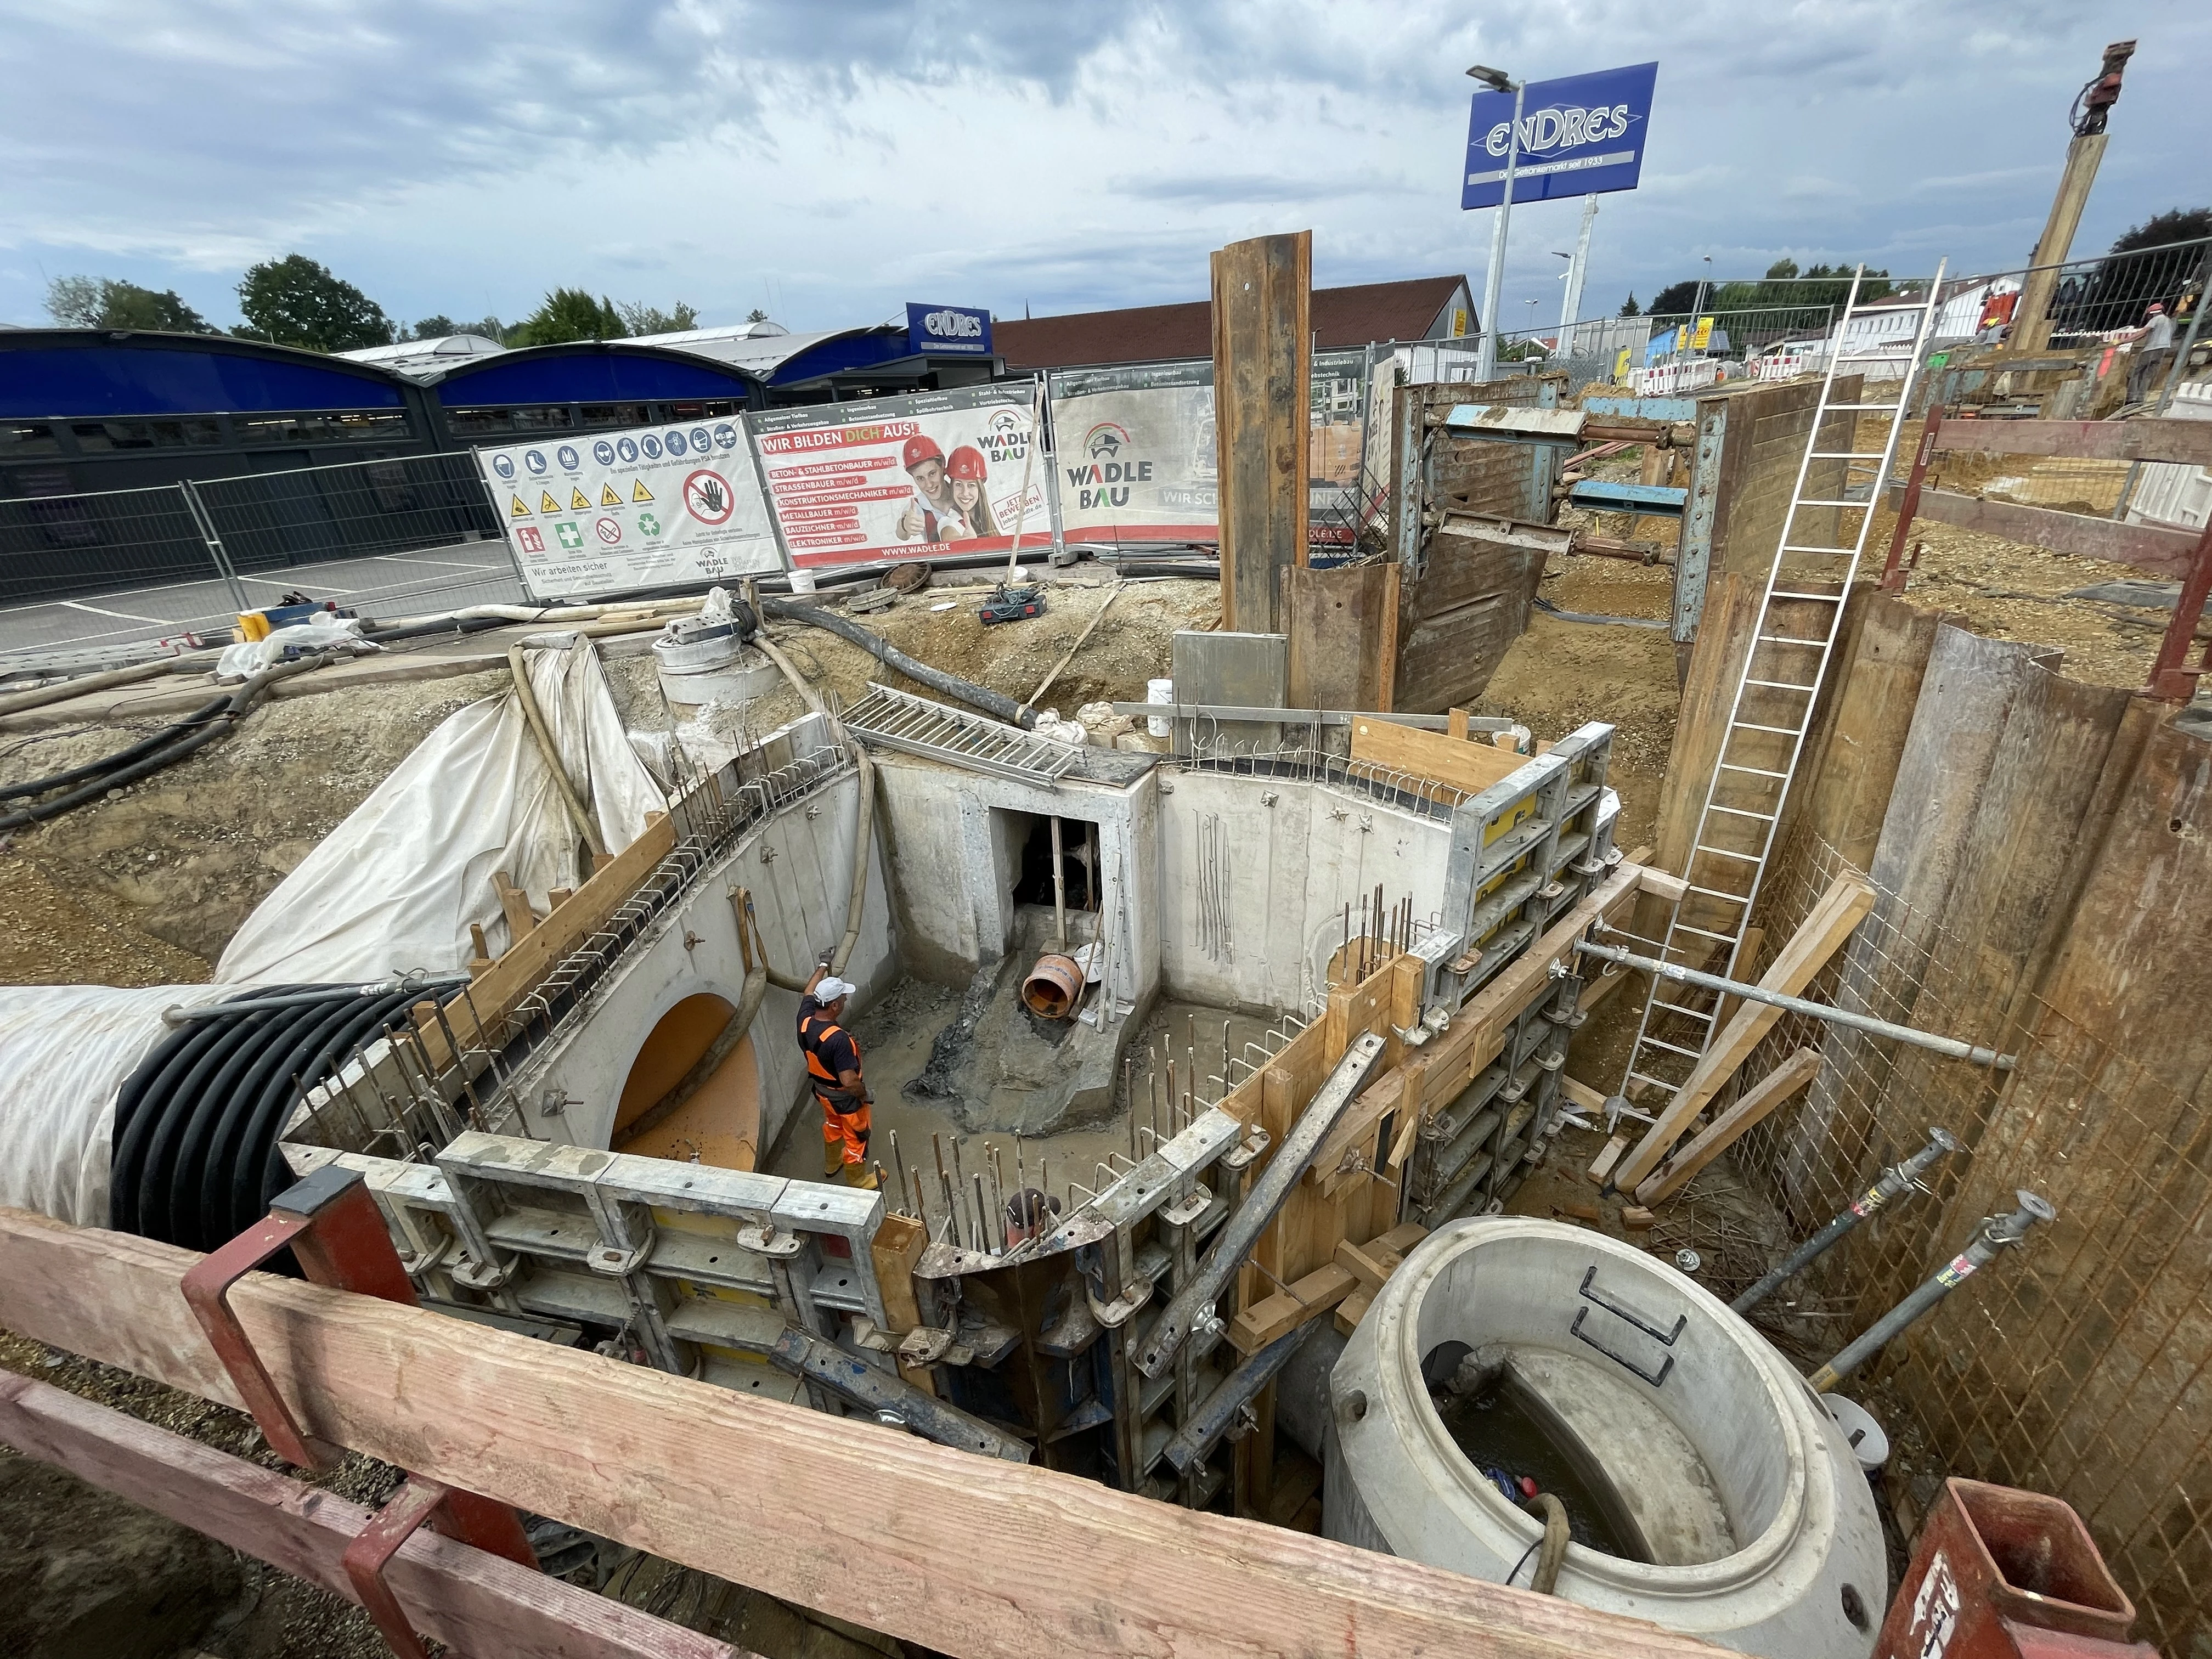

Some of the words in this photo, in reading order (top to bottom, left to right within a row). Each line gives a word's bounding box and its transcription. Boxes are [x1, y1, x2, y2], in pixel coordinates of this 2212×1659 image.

[1486, 104, 1629, 157] ENDRES
[1499, 171, 1508, 179] De
[1514, 162, 1567, 177] Getränkemarkt
[1568, 160, 1582, 170] seit
[1584, 157, 1603, 167] 1933
[924, 310, 982, 337] ENDRES
[1150, 379, 1200, 387] Betoninstandsetzung
[915, 396, 948, 405] Spezialtiefbau
[847, 404, 877, 413] Ingenieurbau
[916, 404, 954, 414] Spülbohrtechnik
[764, 415, 791, 424] Allgemeiner
[791, 420, 829, 428] Verkehrswegebau
[848, 412, 895, 422] Betoninstandsetzung
[763, 437, 792, 452] WIR
[793, 431, 843, 448] BILDEN
[845, 427, 880, 442] DICH
[883, 422, 915, 438] AUS!
[991, 447, 1025, 462] BAU
[771, 469, 797, 479] BETON-
[798, 467, 804, 476] &
[804, 460, 873, 475] STAHLBETONBAUER
[874, 459, 895, 467] m/w/d
[1066, 460, 1153, 488] WADLE
[775, 479, 836, 493] STRASSENBAUER
[836, 478, 859, 487] m/w/d
[778, 488, 888, 506] KONSTRUKTIONSMECHANIKER
[889, 486, 911, 495] m/w/d
[1079, 487, 1130, 511] BAU
[1163, 490, 1191, 504] WIR
[999, 495, 1040, 518] BEWEBEN
[782, 509, 833, 521] METALLBAUER
[834, 507, 856, 516] m/w/d
[1002, 504, 1042, 526] jobs@adle.de
[785, 523, 836, 534] BAUZEICHNER
[837, 521, 858, 530] m/w/d
[790, 537, 843, 548] ELEKTRONIKER
[844, 535, 865, 543] m/w/d
[881, 543, 951, 557] WWW.WADLE.DE
[532, 567, 546, 577] Wir
[549, 565, 582, 575] arbeiten
[583, 561, 608, 572] sicher
[696, 557, 729, 567] WADLE
[706, 566, 724, 574] BAU
